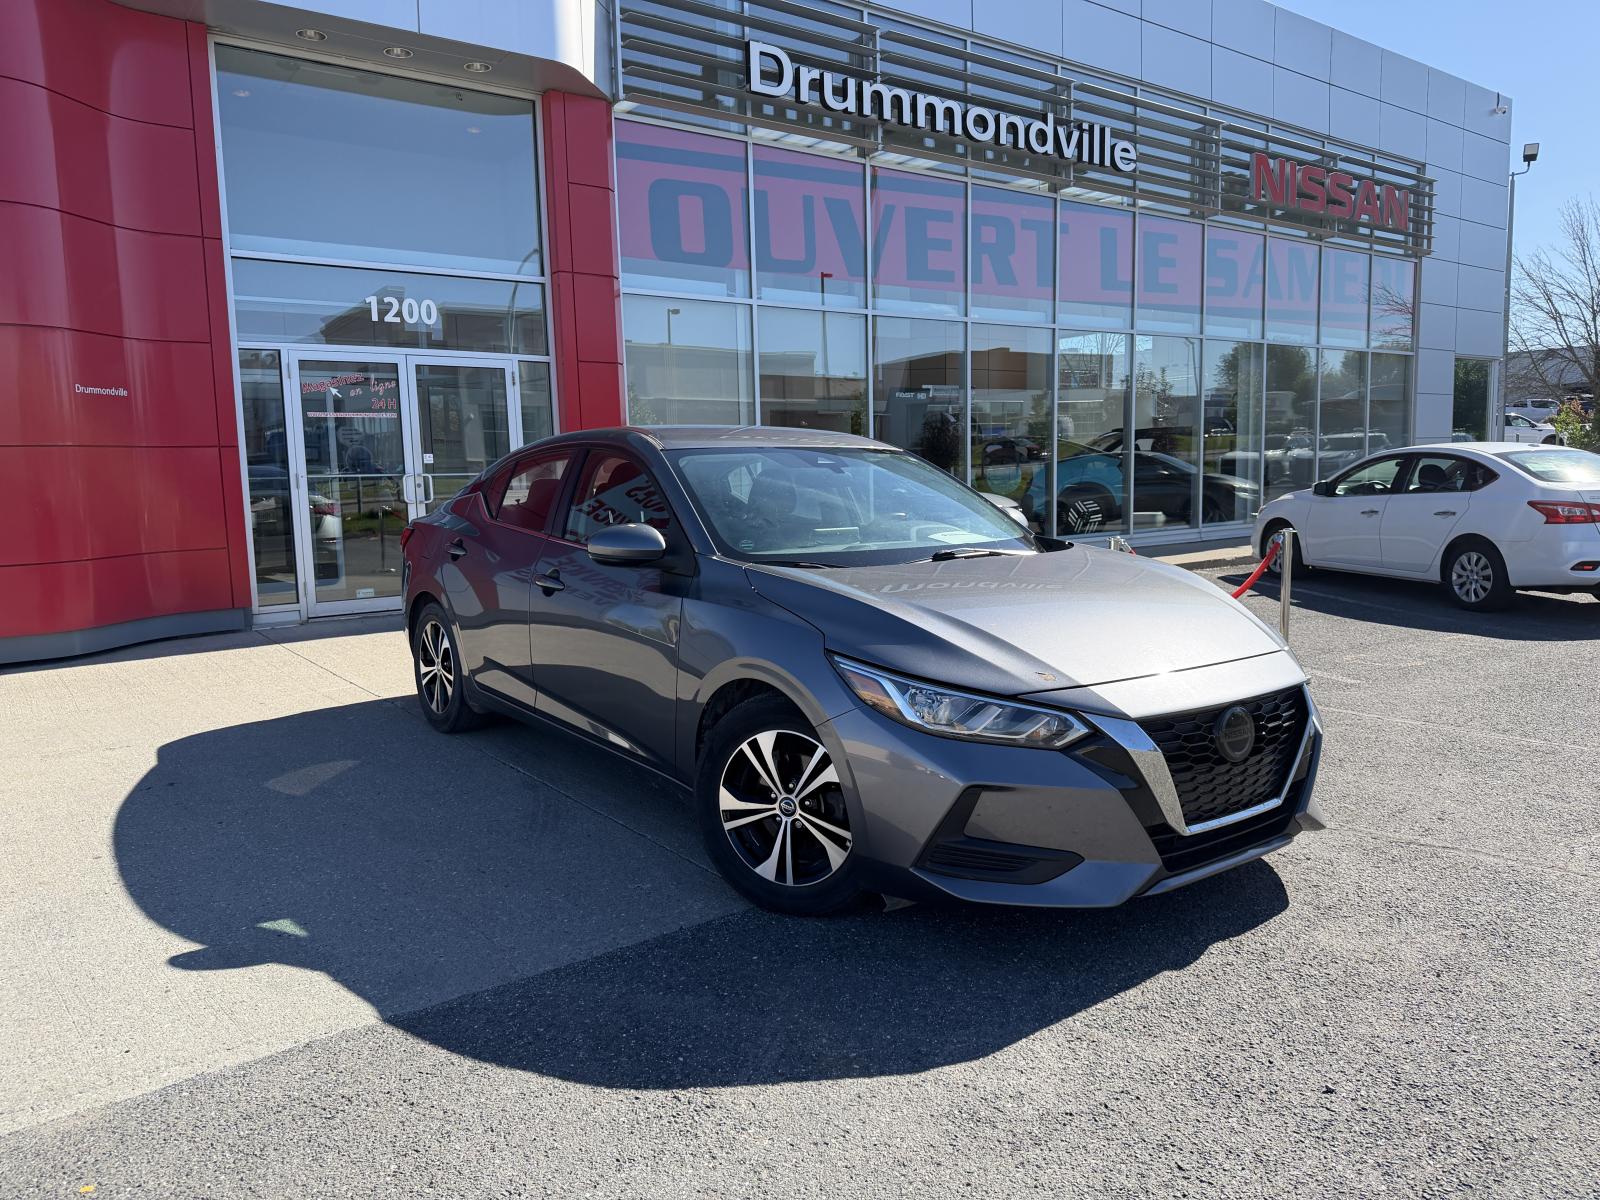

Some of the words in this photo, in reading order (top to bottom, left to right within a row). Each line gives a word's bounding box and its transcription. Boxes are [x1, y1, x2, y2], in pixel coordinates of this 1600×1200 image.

[748, 40, 1137, 172] Drummondville
[1252, 152, 1409, 231] NISSAN
[648, 178, 1069, 289] OUVERT
[1100, 226, 1179, 293] LE
[365, 296, 437, 325] 1200
[75, 383, 128, 396] Drummondville
